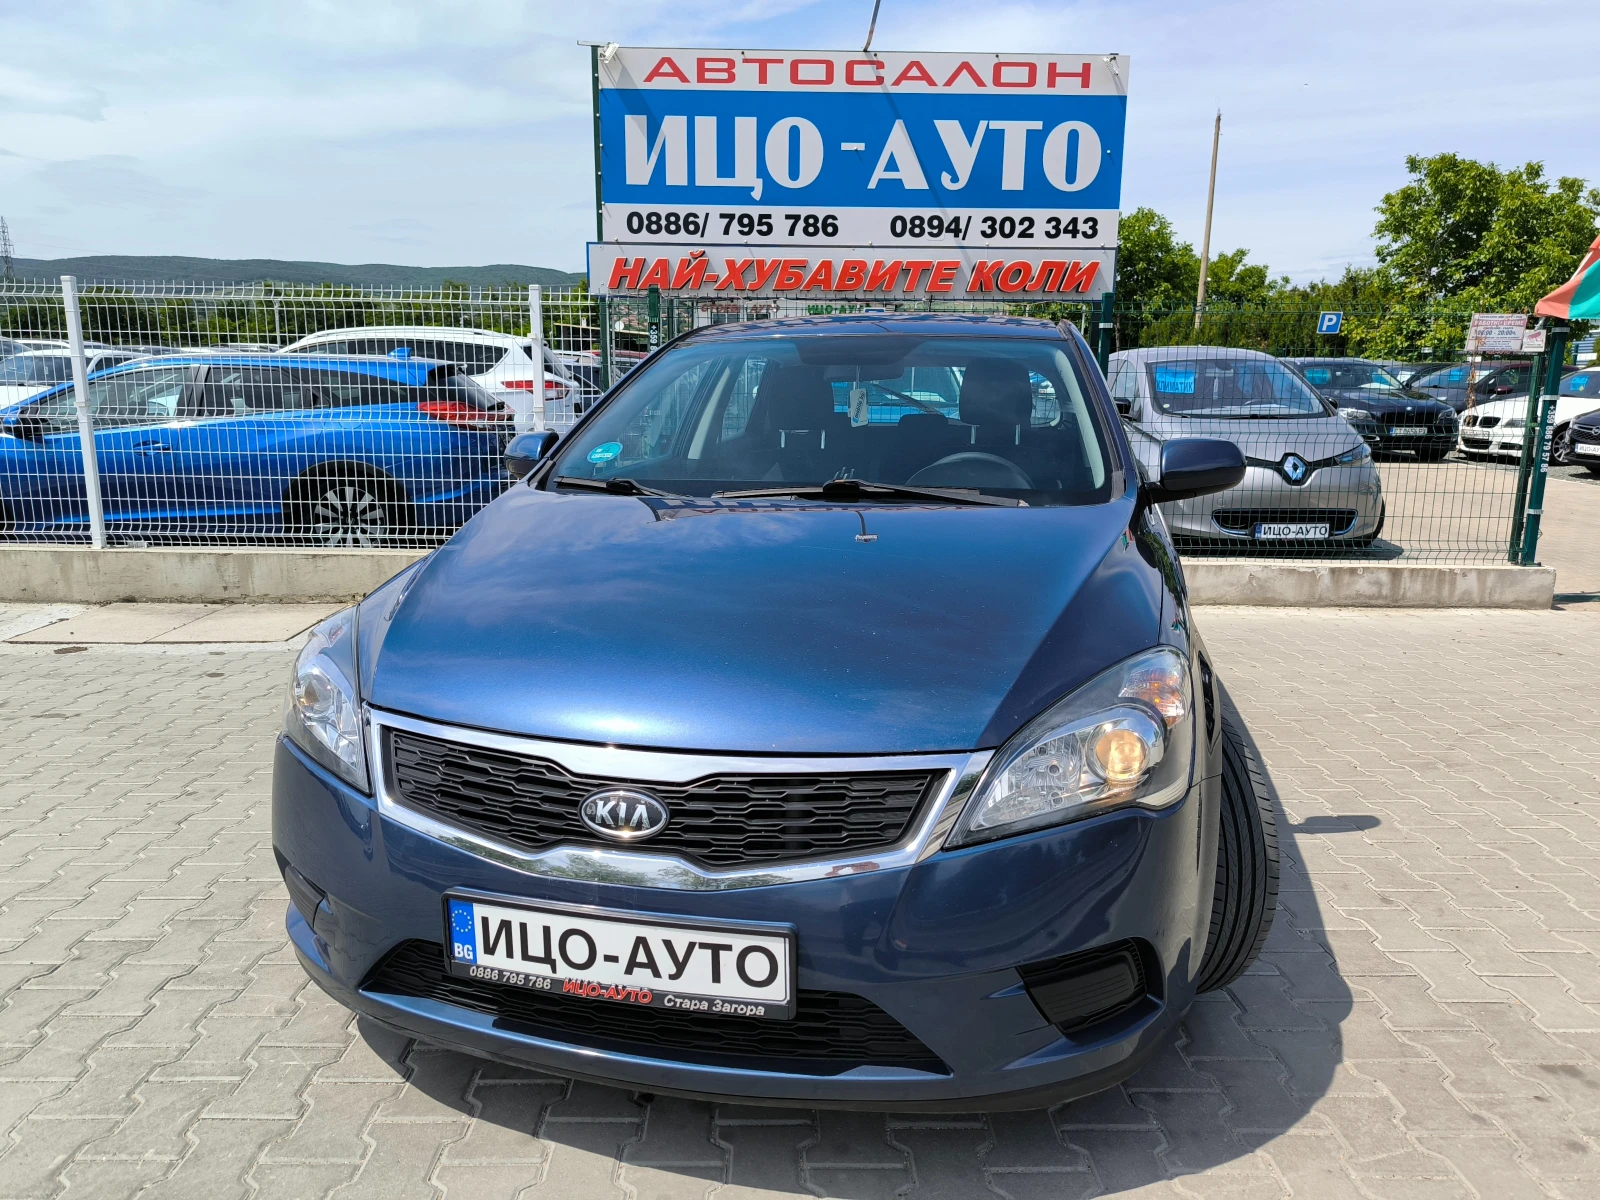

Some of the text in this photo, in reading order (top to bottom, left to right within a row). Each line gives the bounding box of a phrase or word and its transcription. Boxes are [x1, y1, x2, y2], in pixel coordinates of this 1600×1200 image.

[642, 57, 1091, 89] АВТОСАЛОН
[626, 211, 839, 238] 0886/ 795 786
[890, 215, 1099, 240] 0894/ 302 343
[607, 249, 1101, 293] НАЙ-ХУБАВИТЕ КОЛИ
[1322, 314, 1337, 331] P
[1540, 405, 1556, 473] +359 886 79 57 86
[1263, 526, 1328, 537] ИЦО-АУТО
[596, 800, 651, 829] KIA
[454, 943, 474, 960] BG
[481, 916, 779, 988] ИЦО-АУТО
[469, 966, 766, 1017] 0886 795 786 ИЦО-АУТО Стара Загора
